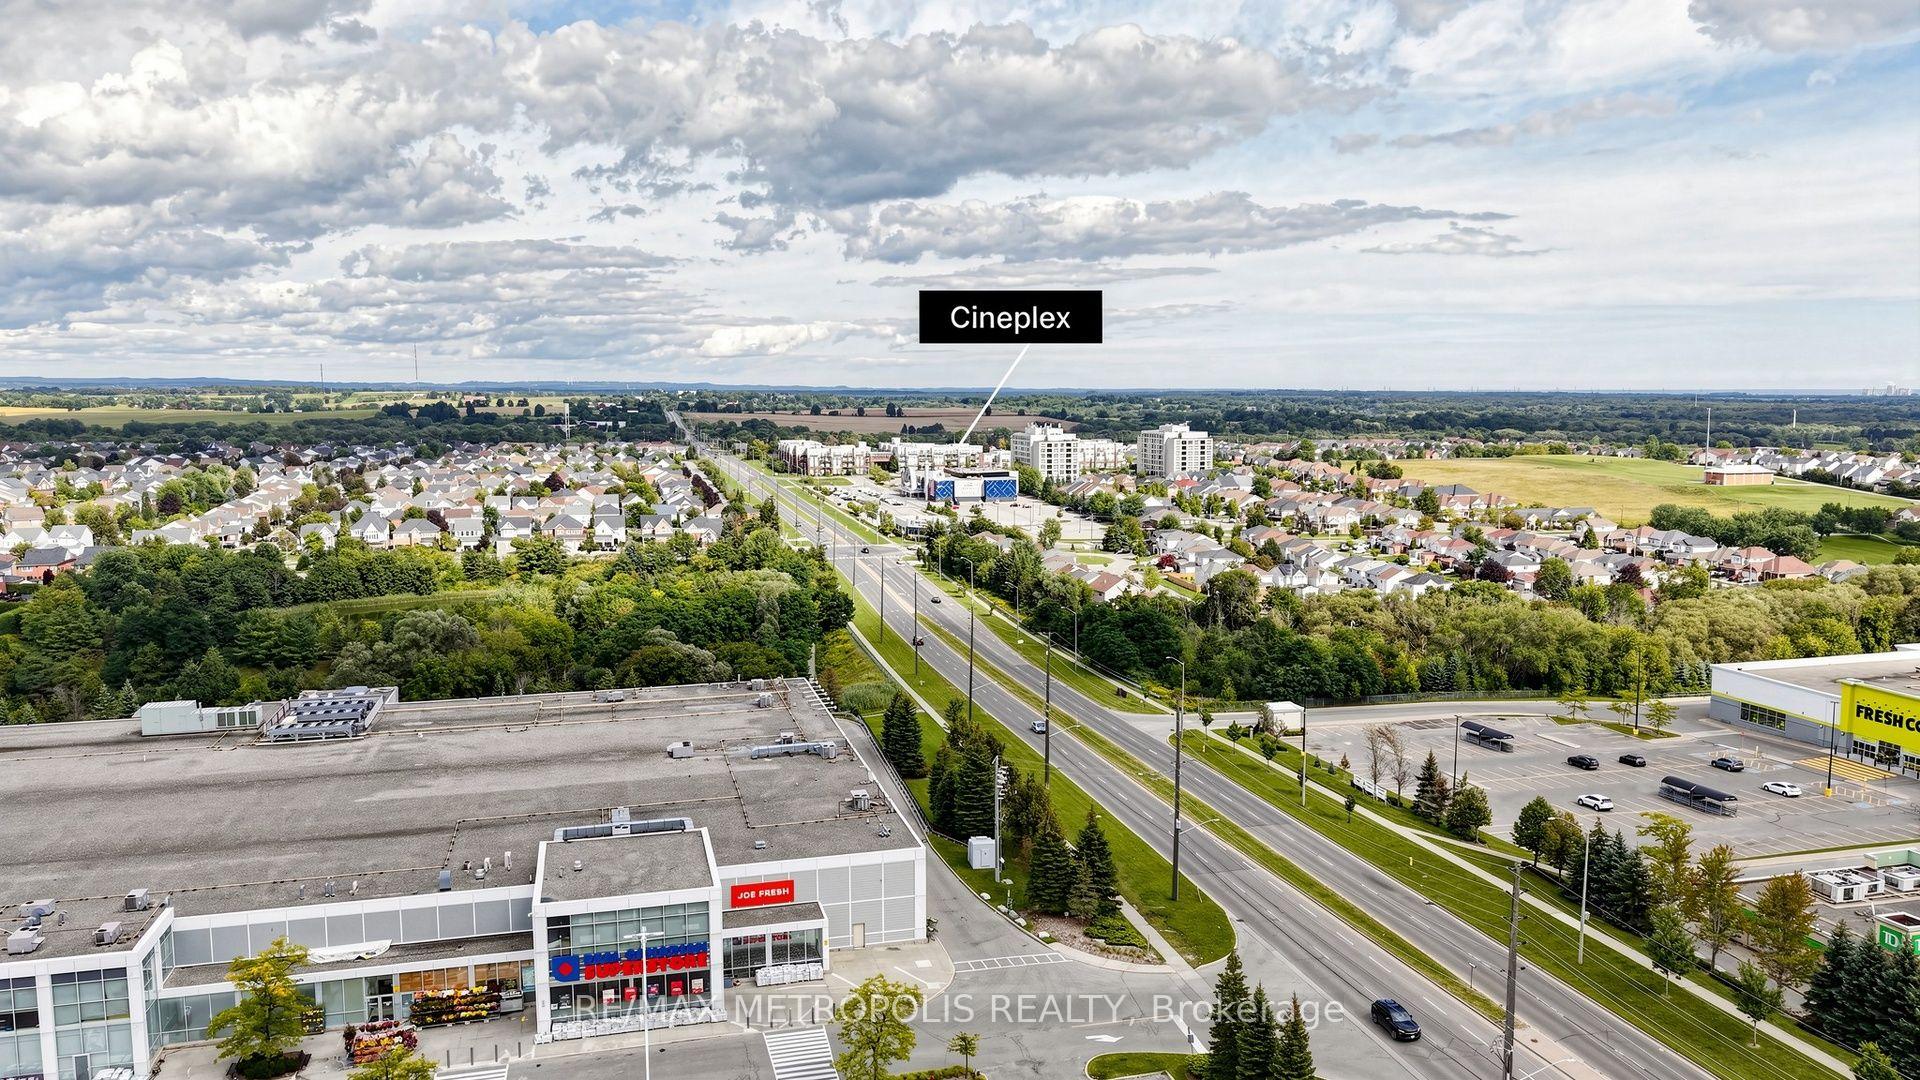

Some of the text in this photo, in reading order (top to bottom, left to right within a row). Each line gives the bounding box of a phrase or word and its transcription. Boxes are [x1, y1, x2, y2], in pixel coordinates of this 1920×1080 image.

[737, 887, 790, 900] JOE FRESH
[1882, 930, 1900, 948] TD
